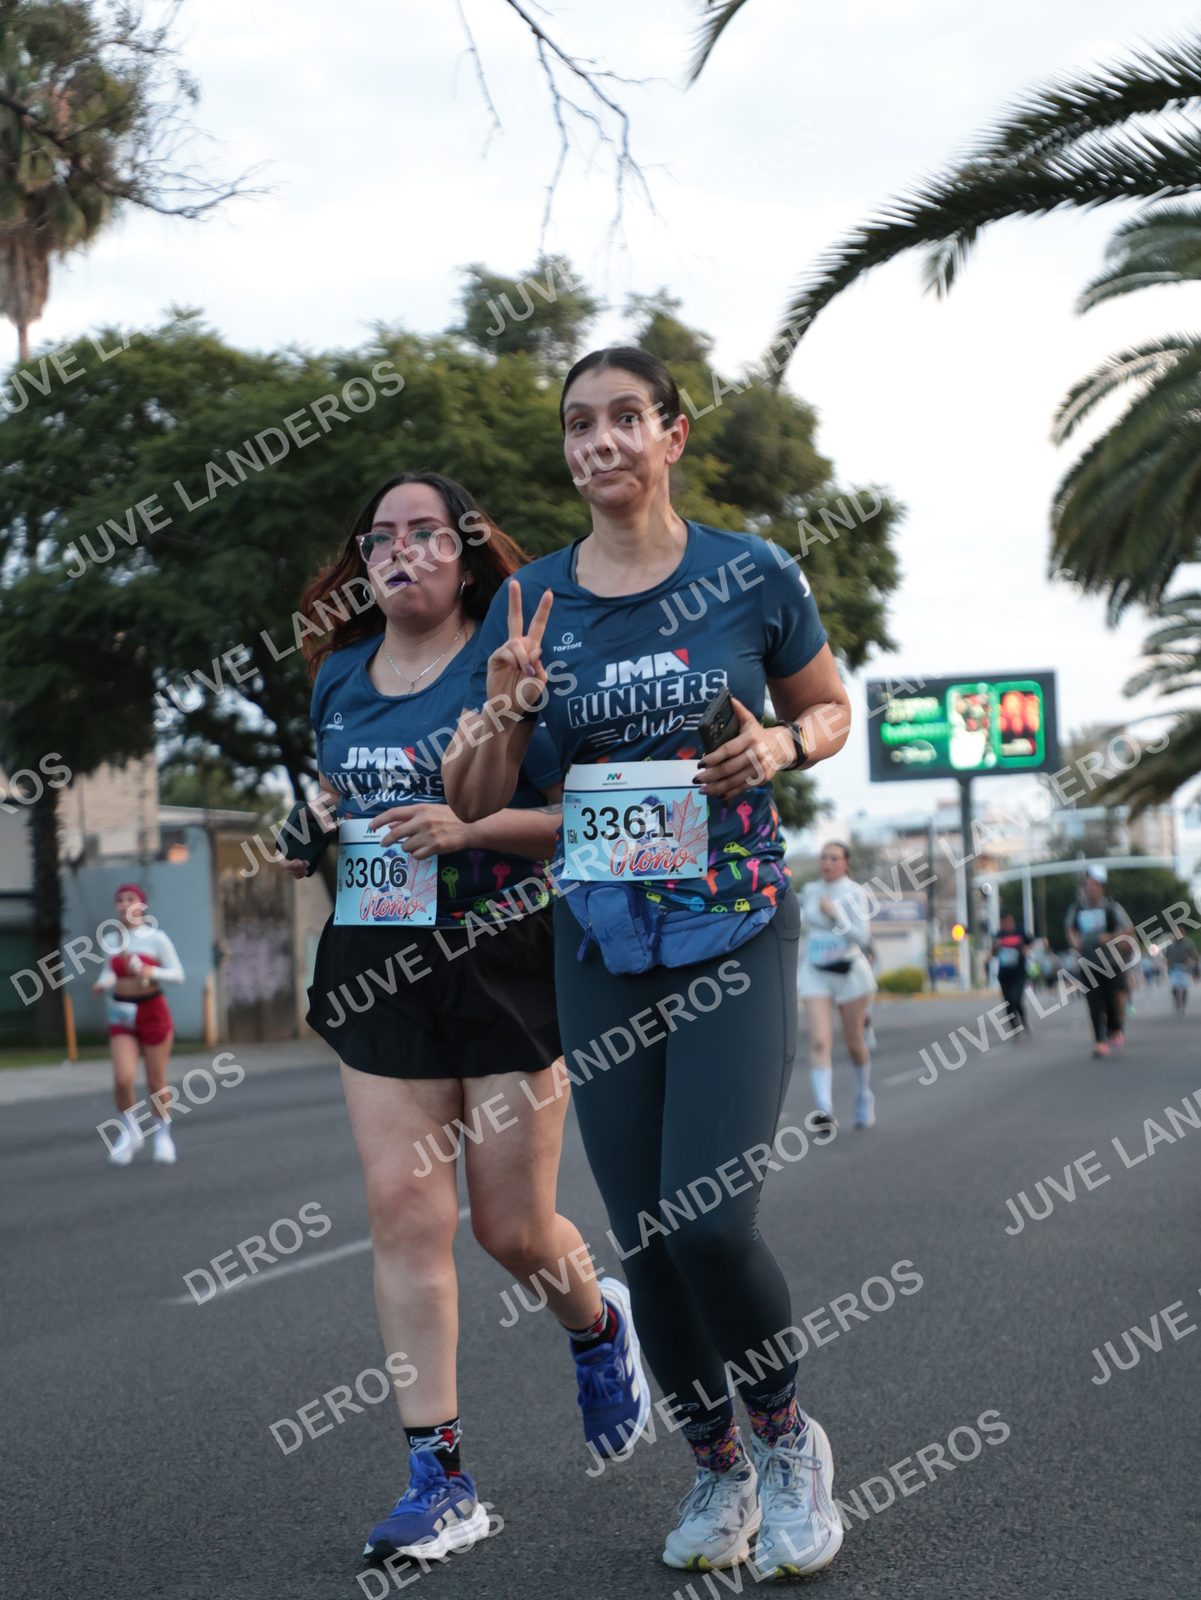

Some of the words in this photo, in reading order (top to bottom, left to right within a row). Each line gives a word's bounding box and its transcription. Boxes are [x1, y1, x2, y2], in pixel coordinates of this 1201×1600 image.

[597, 648, 690, 688] JMA
[567, 669, 727, 729] RUNNERS
[340, 747, 415, 770] JMA
[581, 804, 674, 841] 3361
[345, 857, 408, 889] 3306
